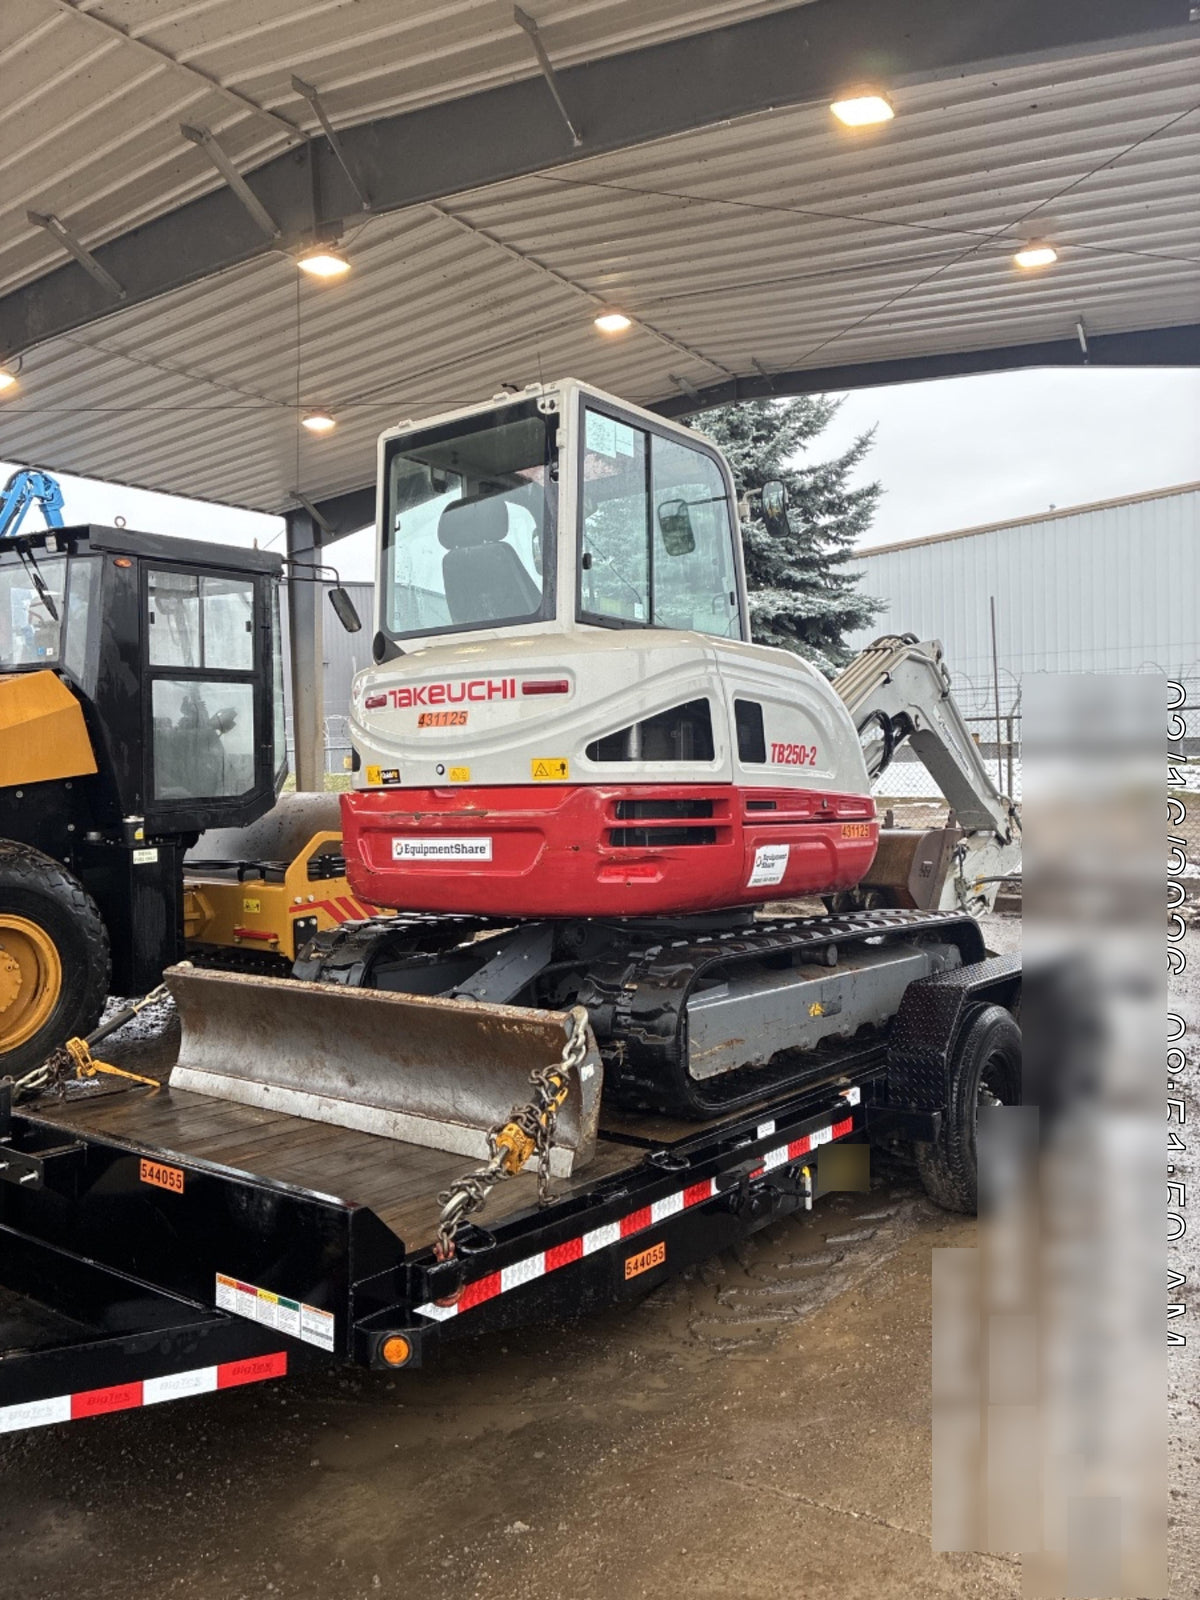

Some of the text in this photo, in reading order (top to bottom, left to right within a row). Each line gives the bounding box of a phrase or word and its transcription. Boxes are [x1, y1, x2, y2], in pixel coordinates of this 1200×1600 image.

[418, 711, 467, 727] 431125
[771, 743, 817, 766] TB250-2
[842, 825, 869, 838] 431125
[404, 842, 486, 859] EquipmentShare
[141, 1163, 182, 1189] 544055
[626, 1245, 664, 1275] 544055
